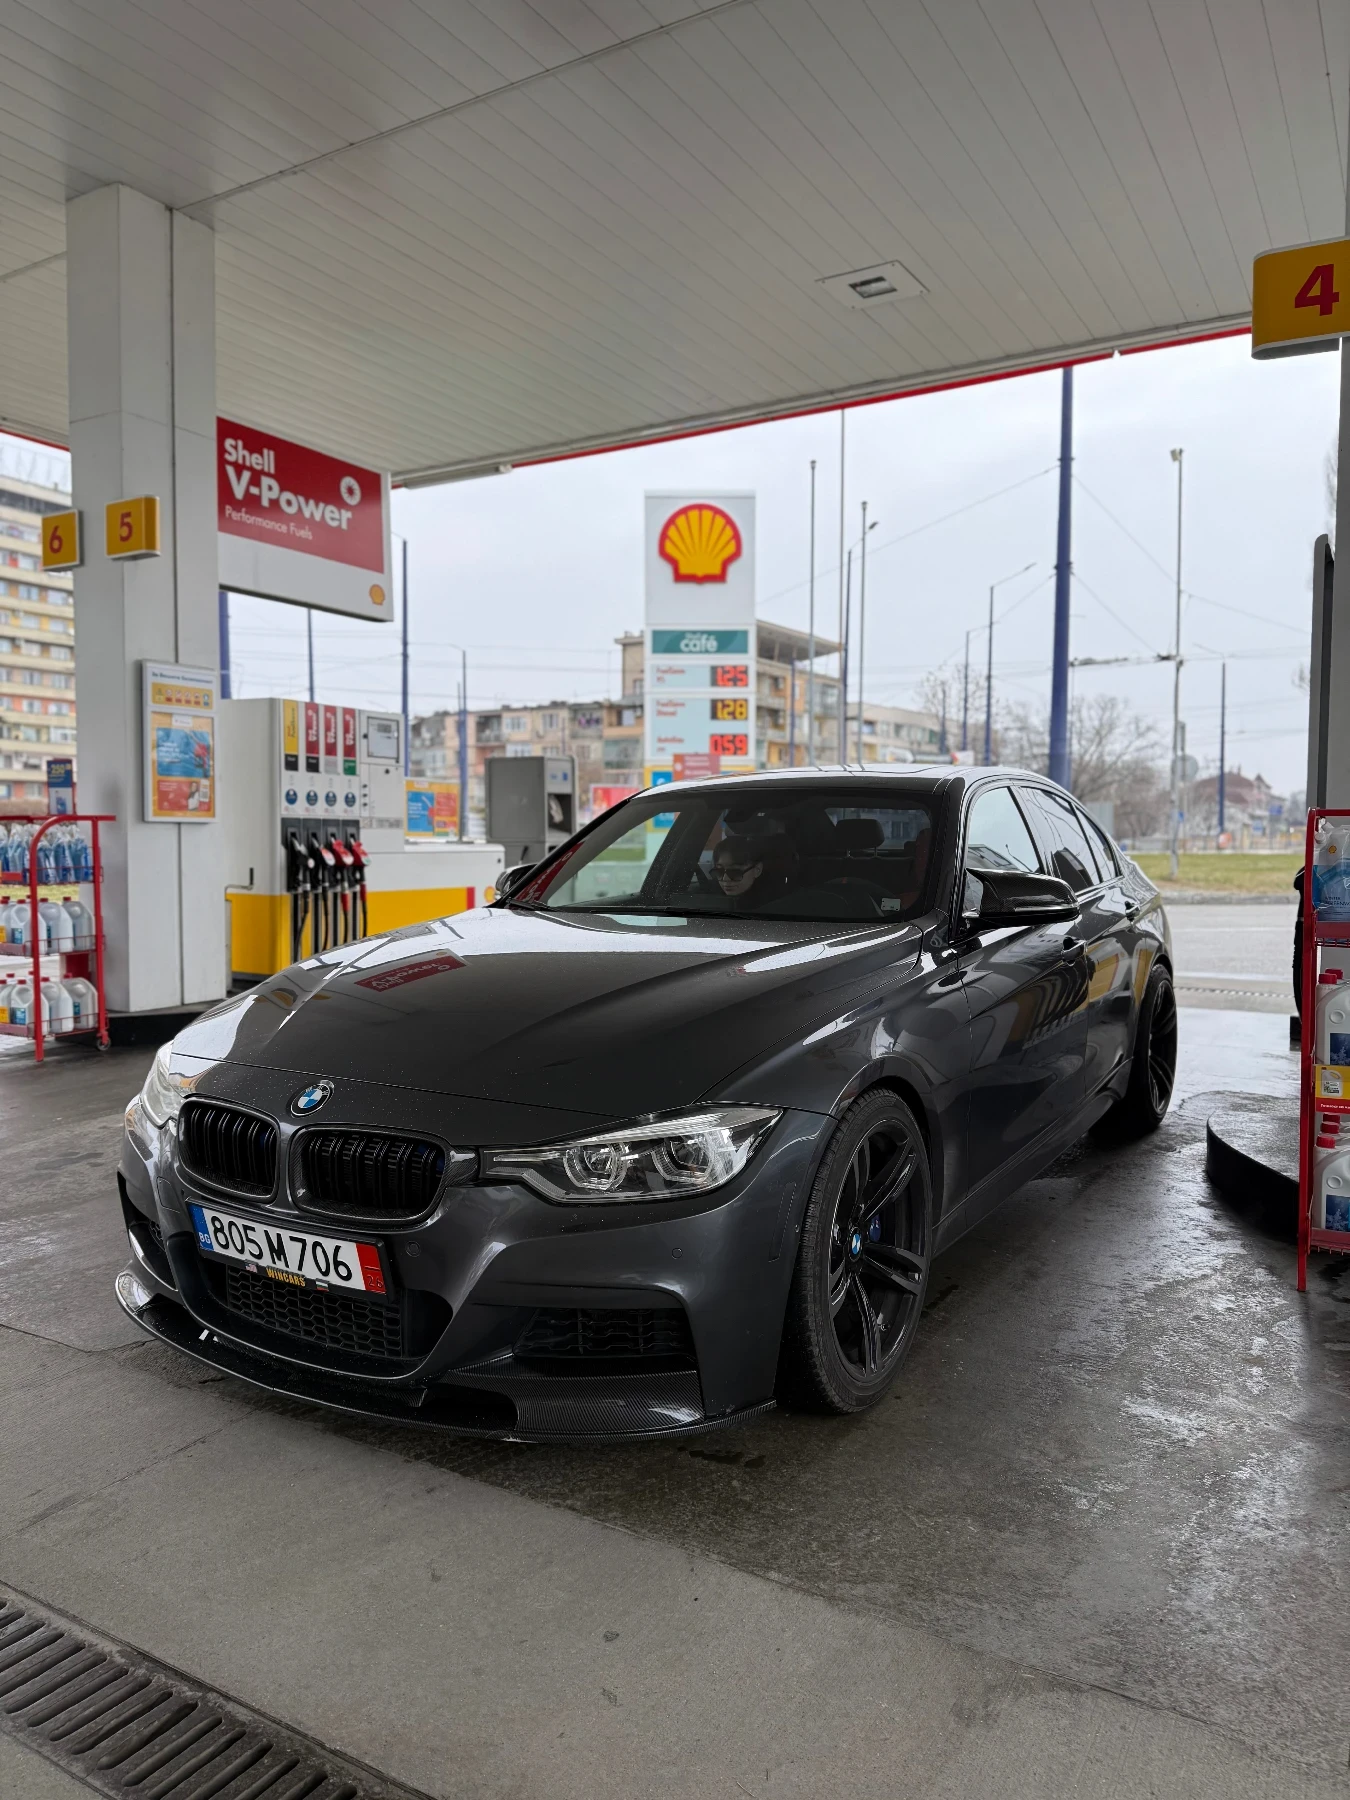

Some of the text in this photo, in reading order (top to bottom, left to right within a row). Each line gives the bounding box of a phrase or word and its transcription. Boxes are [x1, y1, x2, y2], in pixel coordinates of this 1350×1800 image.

[1294, 264, 1340, 317] 4
[224, 437, 275, 474] Shell
[224, 464, 353, 531] V-Power
[118, 511, 134, 543] 5
[224, 505, 313, 541] Performance Fuels
[48, 525, 64, 554] 6
[199, 1231, 212, 1244] BG
[266, 1266, 306, 1288] WINCARS
[367, 1274, 384, 1288] 26
